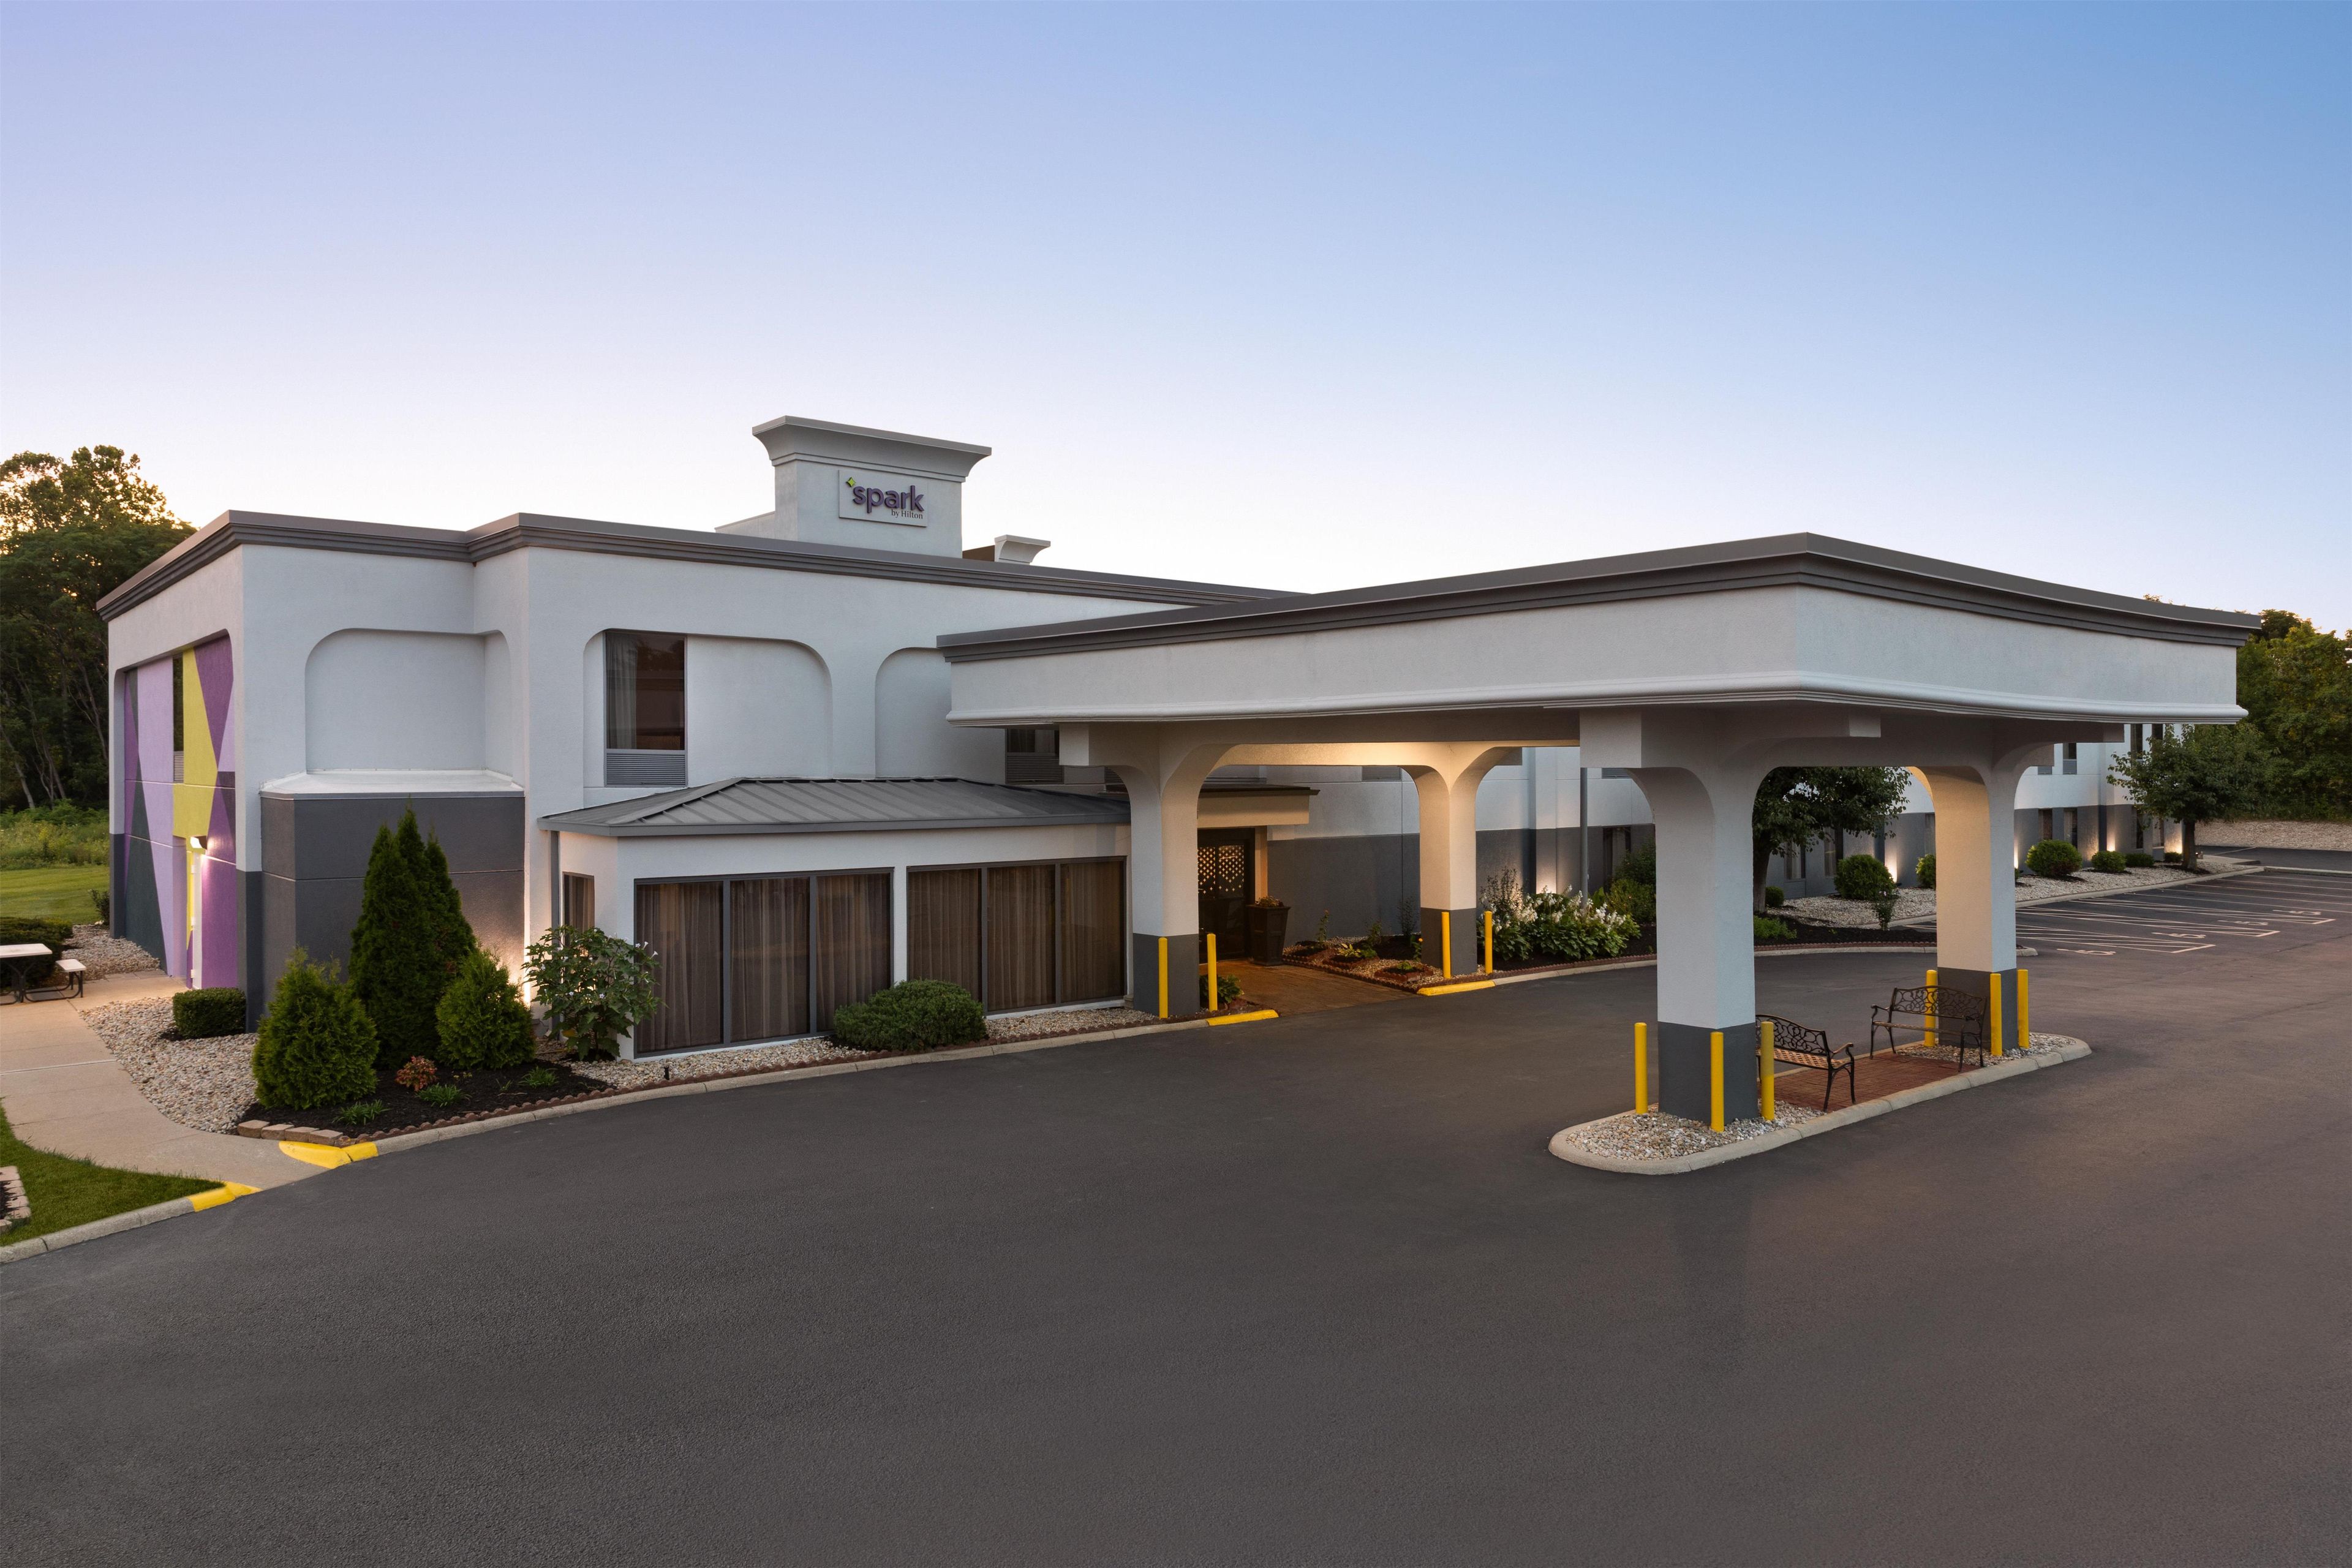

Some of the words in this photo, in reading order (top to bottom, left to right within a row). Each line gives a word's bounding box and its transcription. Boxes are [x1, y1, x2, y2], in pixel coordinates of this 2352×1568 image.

[853, 485, 924, 513] spark
[891, 510, 900, 518] by
[901, 510, 923, 519] Hilton
